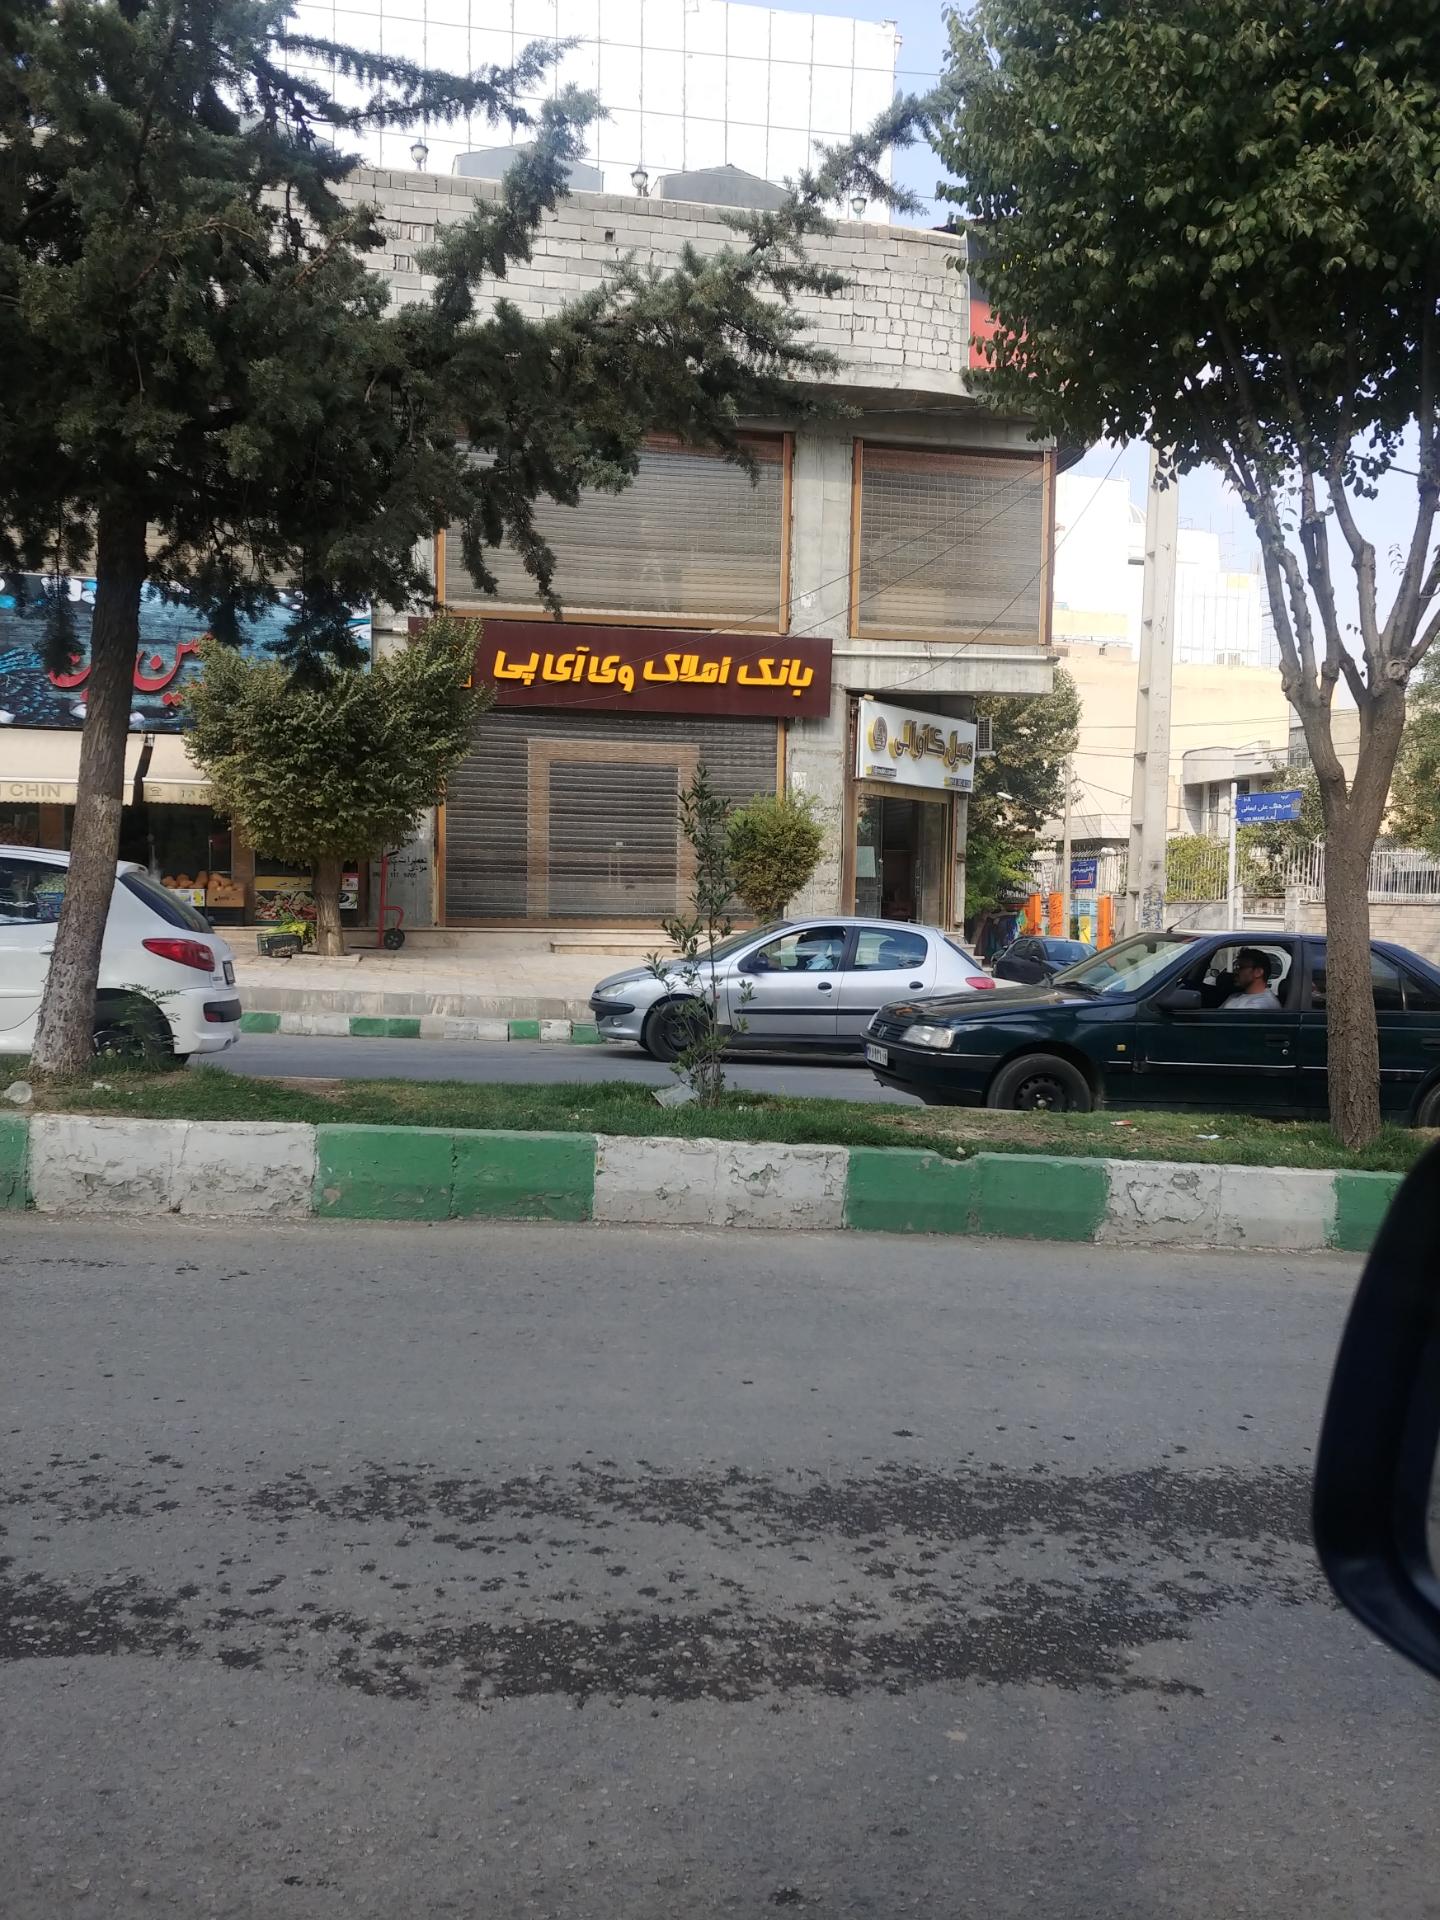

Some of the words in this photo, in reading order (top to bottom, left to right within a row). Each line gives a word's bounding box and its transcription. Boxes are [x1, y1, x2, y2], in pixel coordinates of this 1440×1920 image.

[493, 649, 540, 687] پی
[541, 646, 591, 683] آی
[587, 654, 635, 694] وی
[642, 653, 732, 684] املاک
[736, 657, 814, 697] بانک
[9, 783, 61, 798] CHIN
